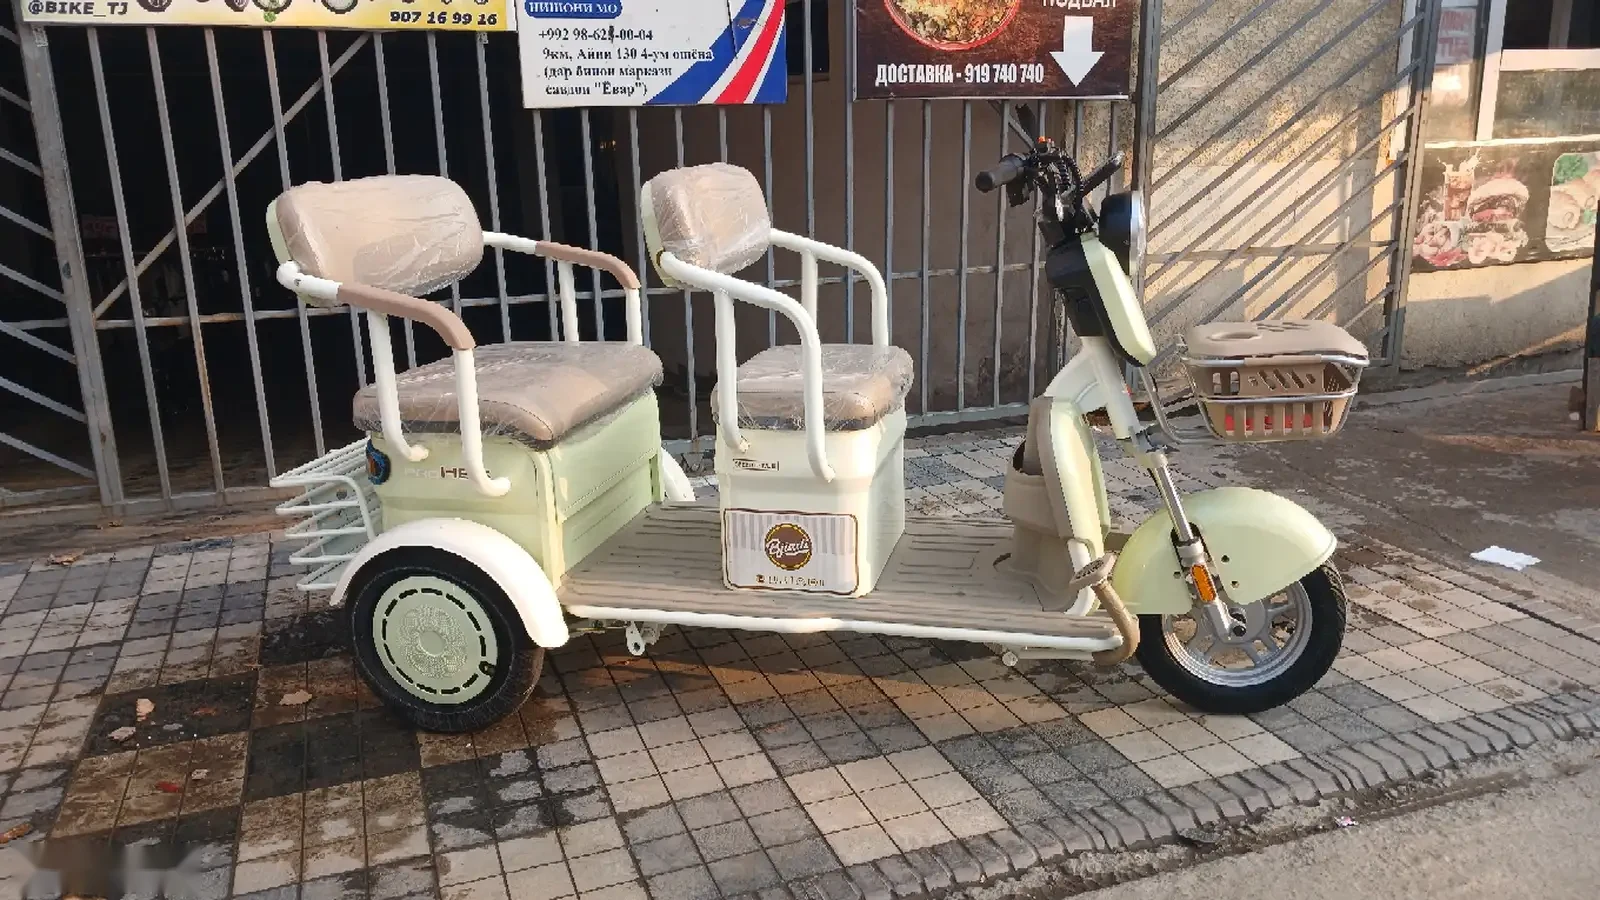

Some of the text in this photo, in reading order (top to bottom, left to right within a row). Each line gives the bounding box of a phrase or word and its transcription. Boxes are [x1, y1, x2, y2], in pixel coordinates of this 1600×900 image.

[28, 0, 128, 17] @BIKE_TJ
[390, 11, 497, 26] 907 16 99 16
[538, 28, 569, 41] +992
[542, 47, 573, 61] 9км,
[617, 47, 637, 60] 130
[640, 48, 669, 62] 4-ум
[544, 65, 573, 80] (дар
[875, 63, 954, 87] ДОСТАВКА
[964, 63, 990, 84] 919
[992, 63, 1017, 84] 740
[1020, 63, 1044, 84] 740
